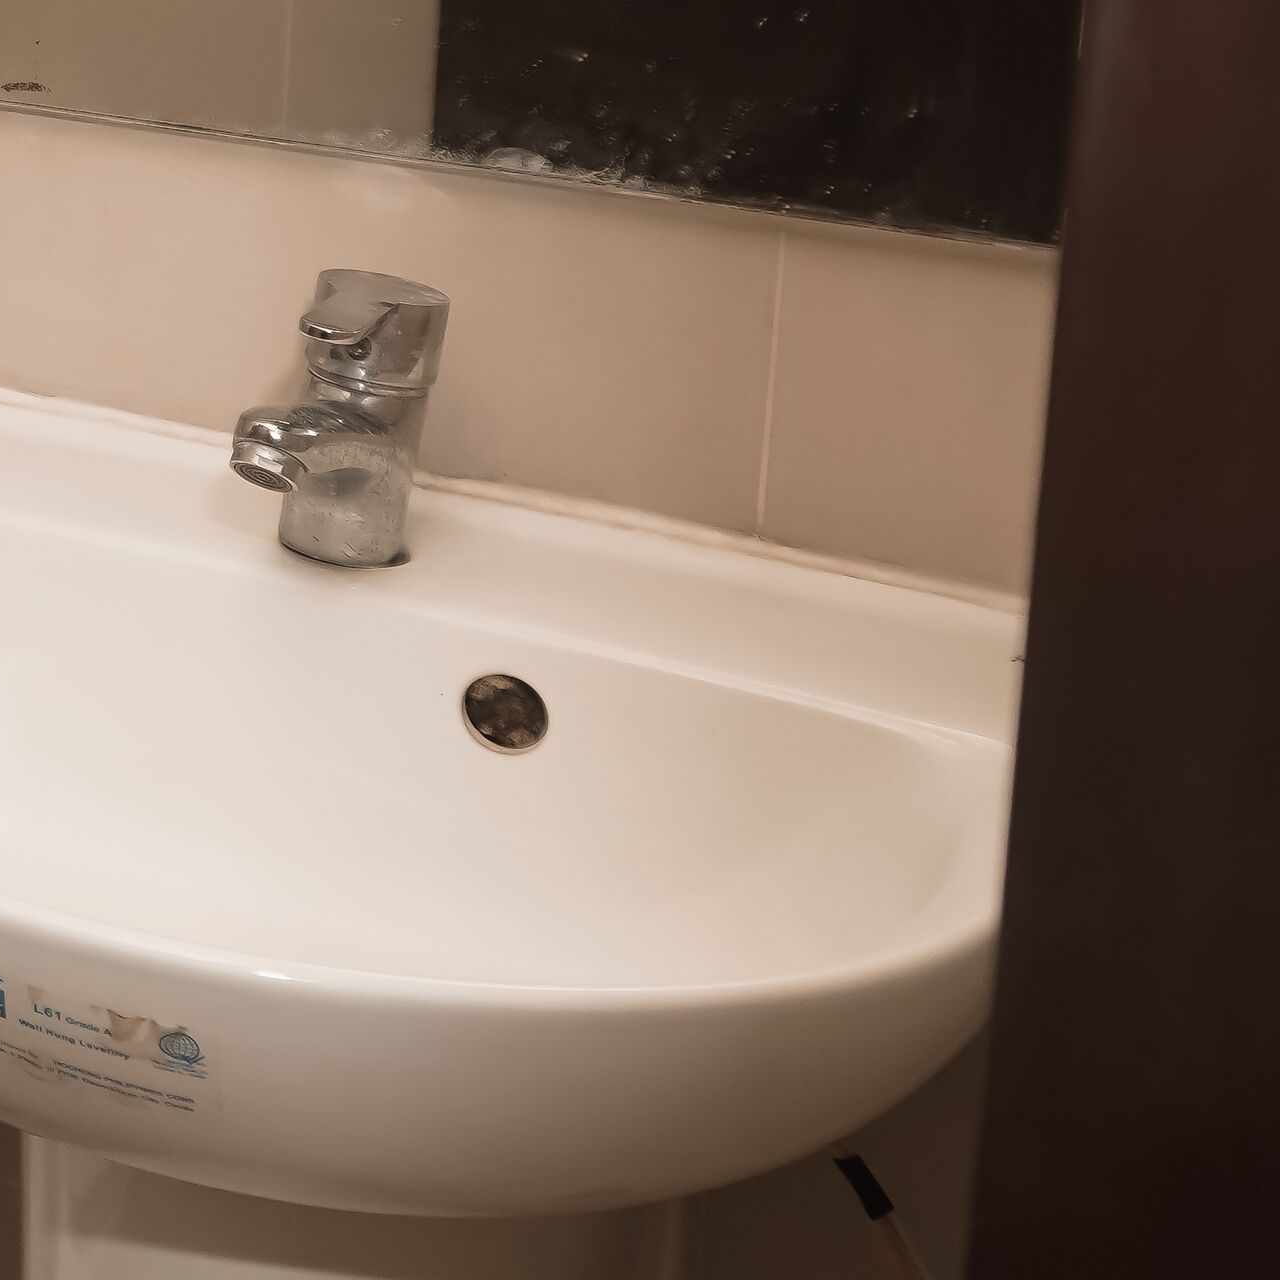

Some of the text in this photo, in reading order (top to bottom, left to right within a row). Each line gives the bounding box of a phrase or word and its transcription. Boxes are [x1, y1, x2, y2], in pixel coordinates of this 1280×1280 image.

[19, 1018, 43, 1032] Wall
[46, 1028, 76, 1046] Hung
[34, 1003, 61, 1021] L61
[65, 1017, 100, 1033] Grade
